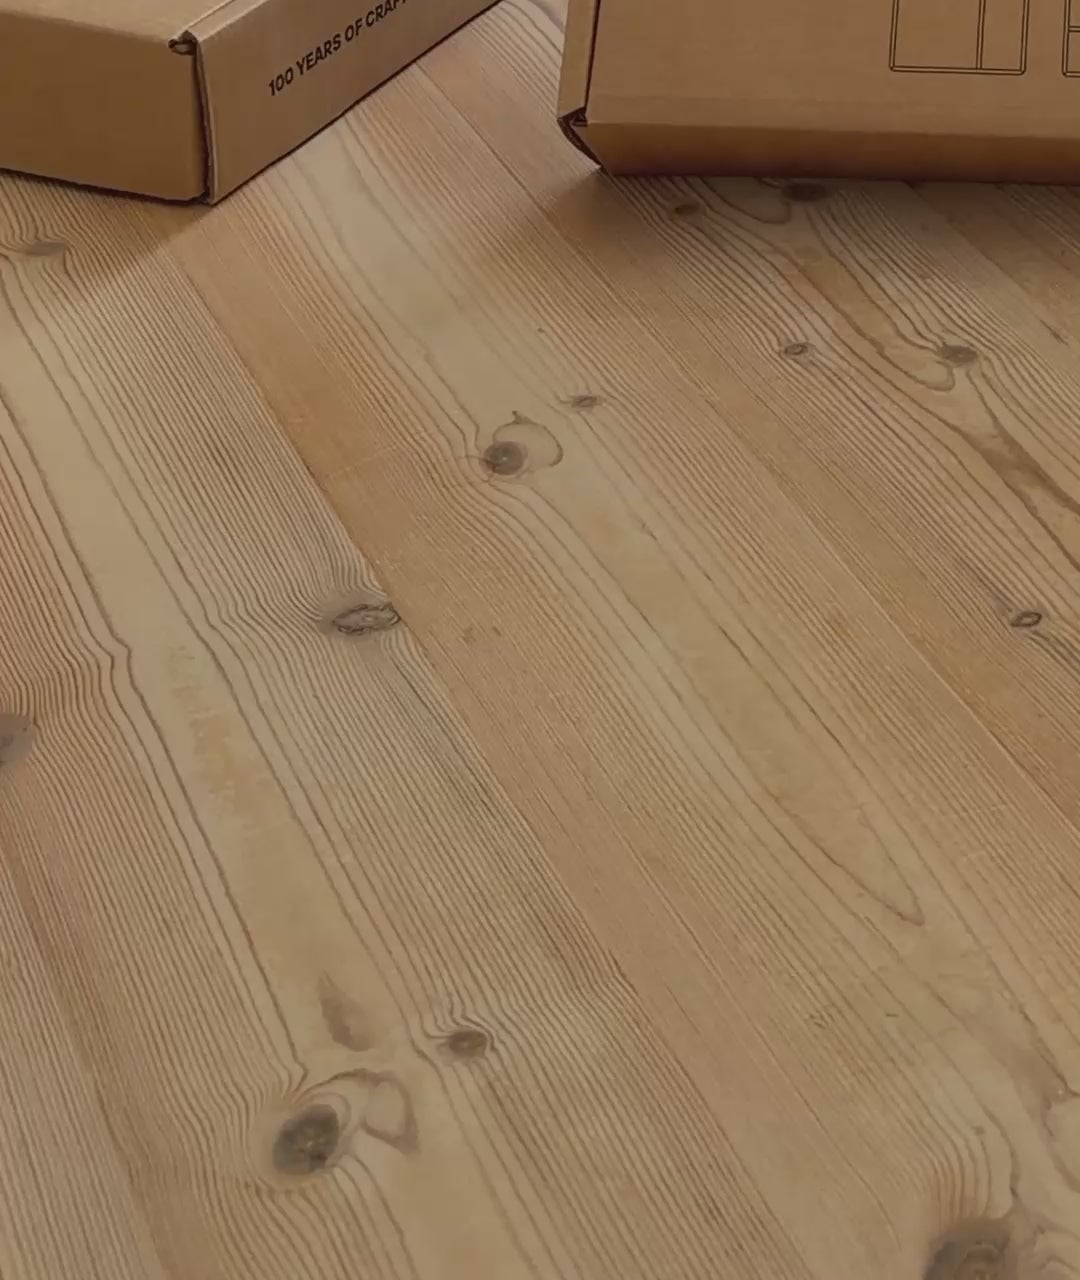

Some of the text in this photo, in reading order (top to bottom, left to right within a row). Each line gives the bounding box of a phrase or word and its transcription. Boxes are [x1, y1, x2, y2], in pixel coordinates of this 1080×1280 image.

[268, 66, 294, 96] 100
[296, 33, 341, 75] YEARS
[344, 18, 363, 42] OF
